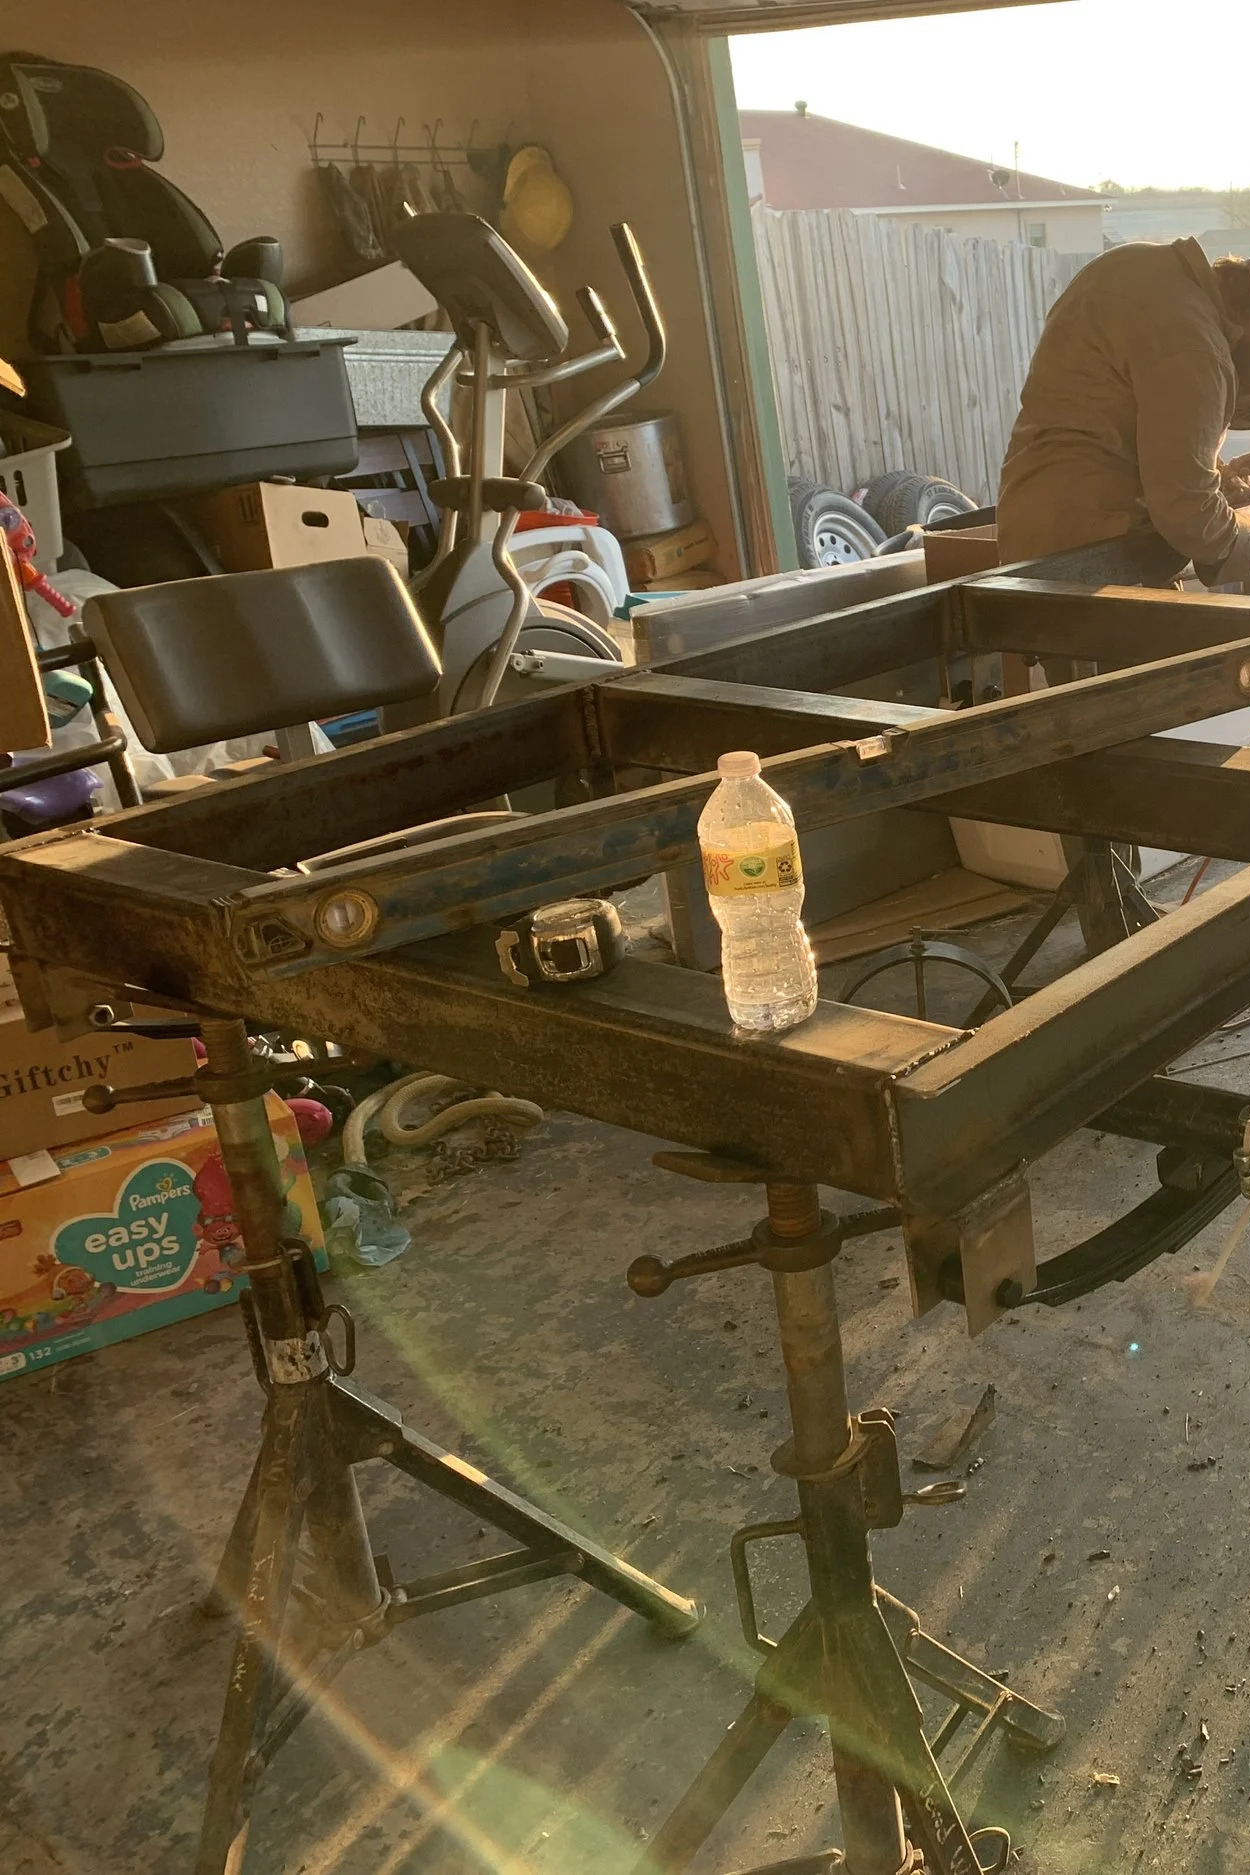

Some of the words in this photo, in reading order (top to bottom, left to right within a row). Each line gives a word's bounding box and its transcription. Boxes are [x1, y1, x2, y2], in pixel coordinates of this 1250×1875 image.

[129, 1184, 191, 1212] Pampers
[84, 1212, 168, 1253] easy
[112, 1235, 180, 1271] ups
[130, 1266, 181, 1286] underwear
[135, 1261, 173, 1278] training
